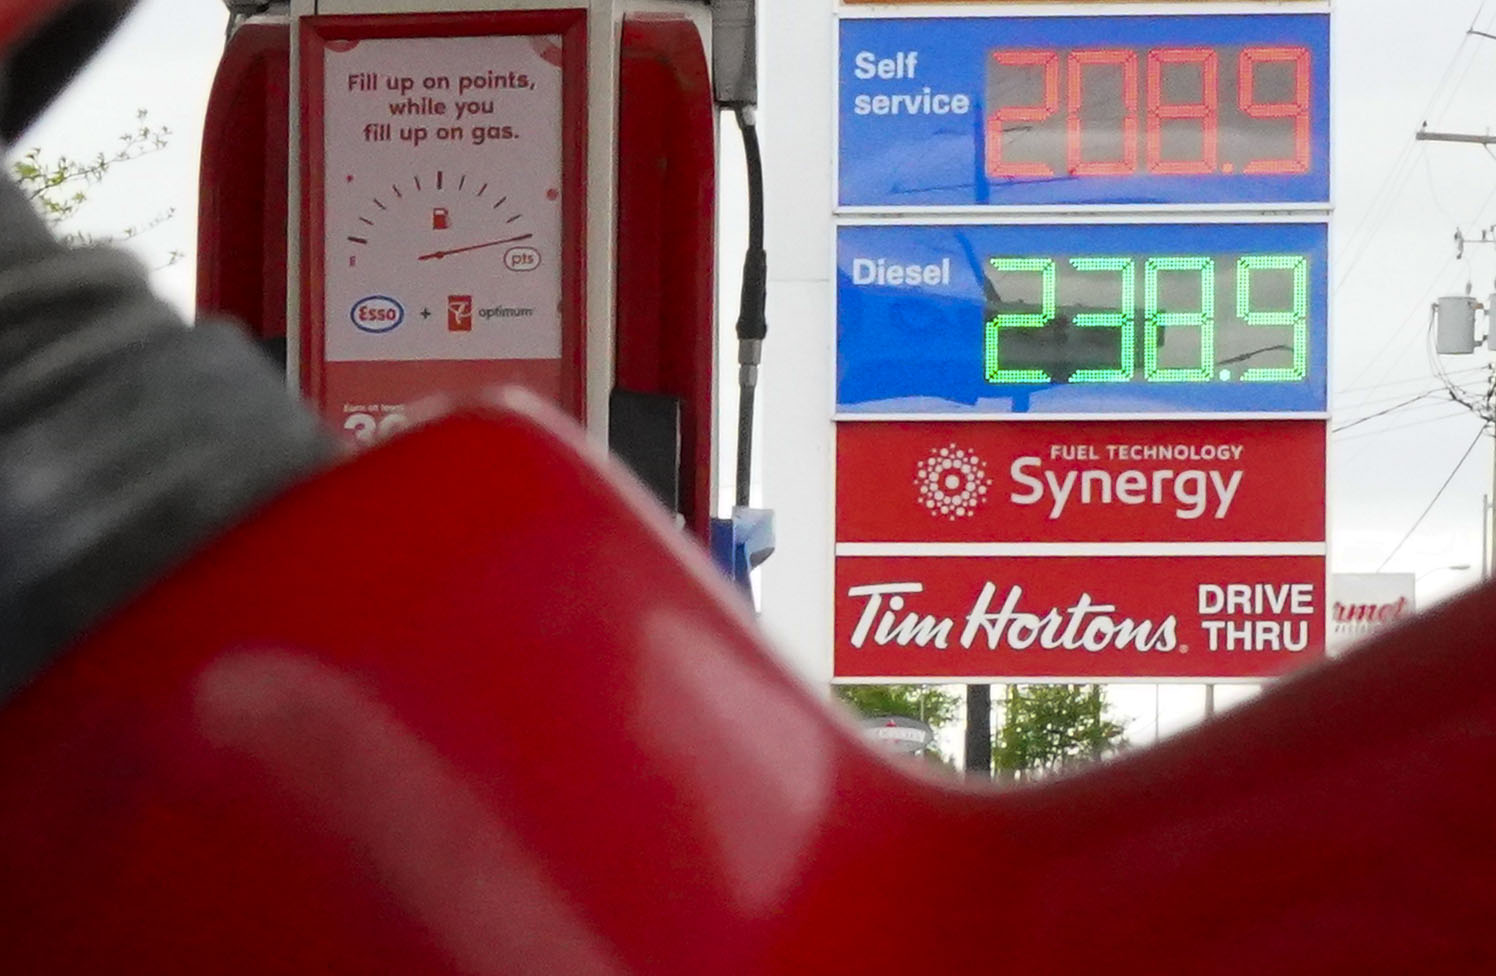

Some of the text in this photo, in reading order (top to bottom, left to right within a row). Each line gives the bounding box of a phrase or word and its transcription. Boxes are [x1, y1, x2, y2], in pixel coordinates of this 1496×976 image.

[854, 51, 917, 80] Self
[348, 70, 535, 95] Fill up on points,
[389, 98, 494, 120] while you
[854, 87, 970, 115] service
[985, 46, 1310, 177] 208.9
[363, 124, 520, 146] fill up on gas.
[511, 252, 534, 266] pts
[852, 258, 950, 286] Diesel
[359, 306, 396, 321] Esso
[478, 305, 533, 320] optimum
[985, 255, 1307, 384] 238.9
[1050, 445, 1244, 460] FUEL TECHNOLOGY
[1010, 456, 1244, 519] Synergy
[1198, 583, 1314, 615] DRIVE
[848, 581, 1177, 652] Tim Hortons
[1202, 621, 1308, 652] THRU
